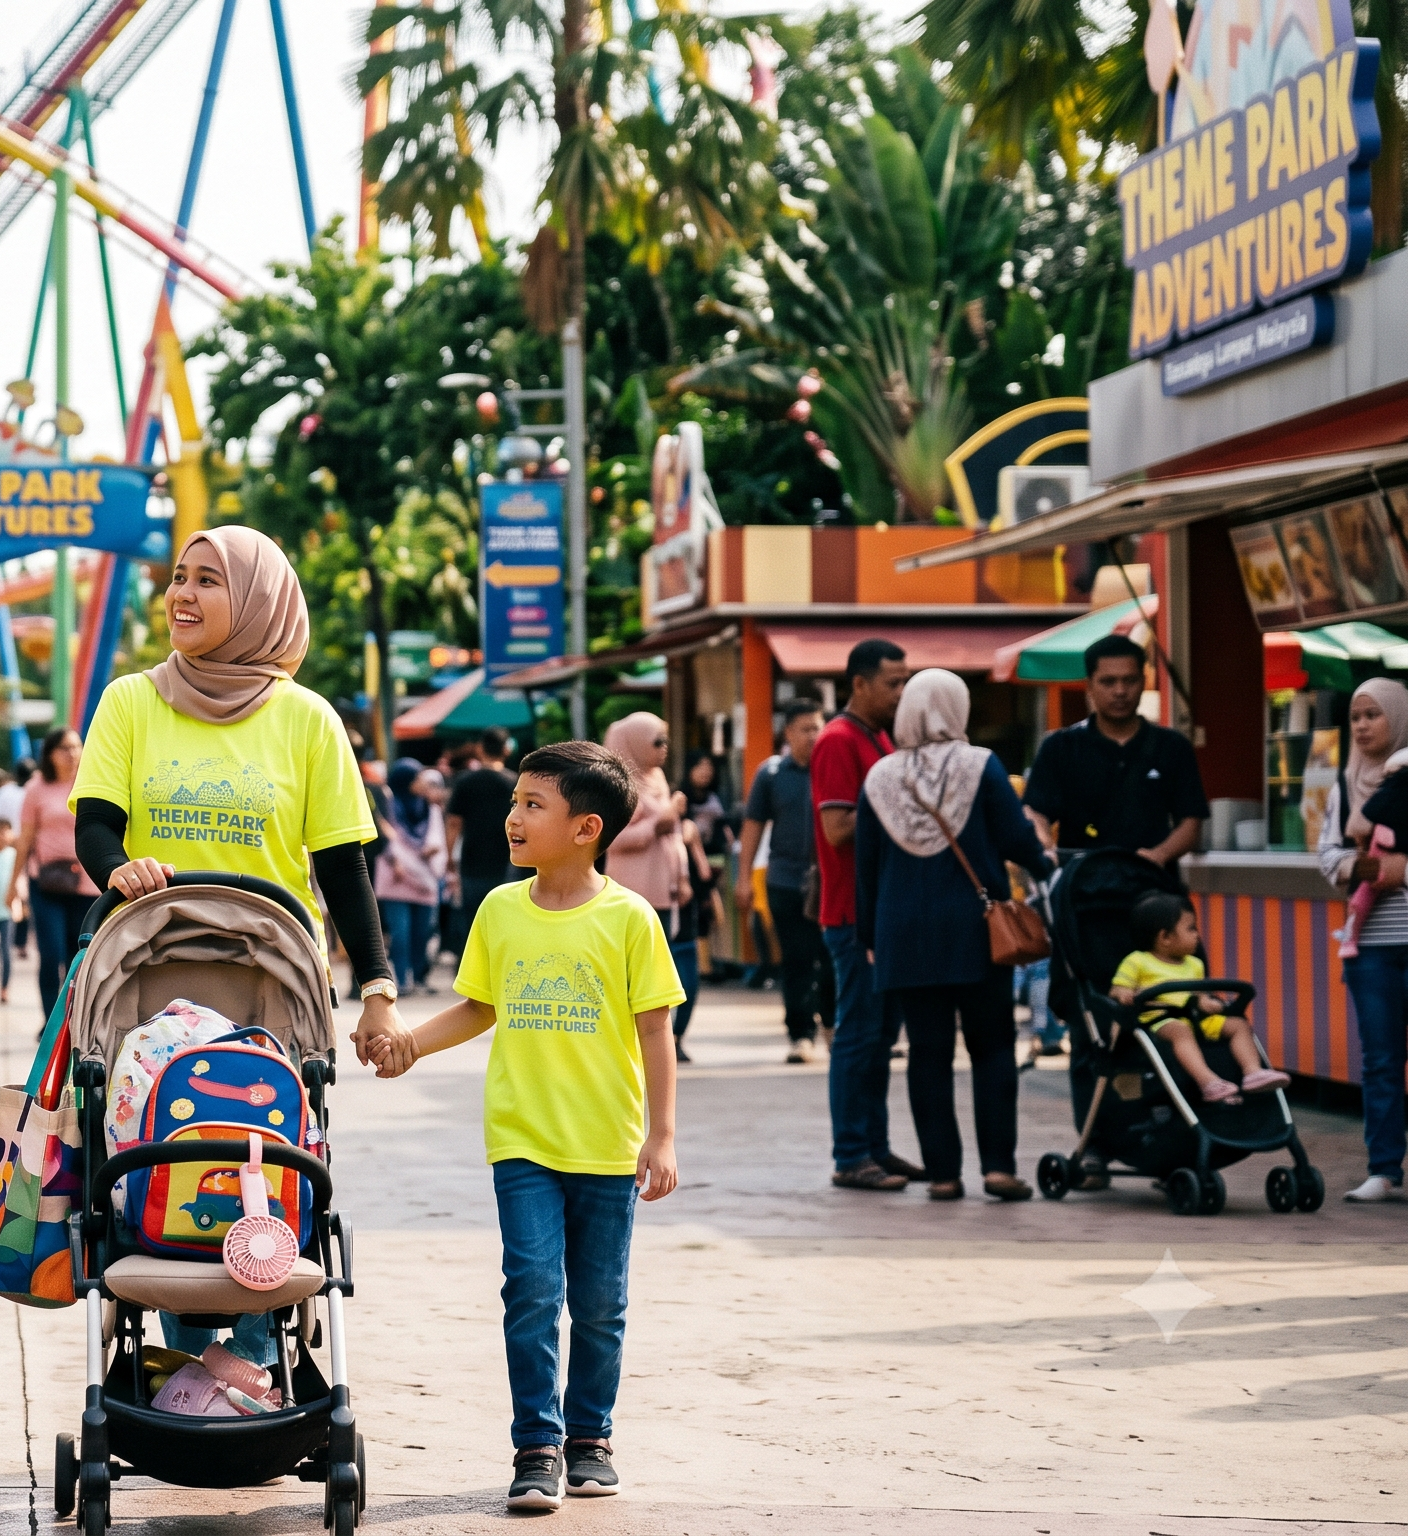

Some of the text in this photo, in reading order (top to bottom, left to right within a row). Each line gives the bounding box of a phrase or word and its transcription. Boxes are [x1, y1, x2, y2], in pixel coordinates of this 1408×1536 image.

[1120, 50, 1358, 262] THEME PARK
[1130, 176, 1349, 352] ADVENTURES
[148, 808, 267, 832] THEME PARK
[150, 825, 263, 848] ADVENTURES
[506, 1003, 601, 1020] THEME PARK
[507, 1018, 596, 1034] ADVENTURES
